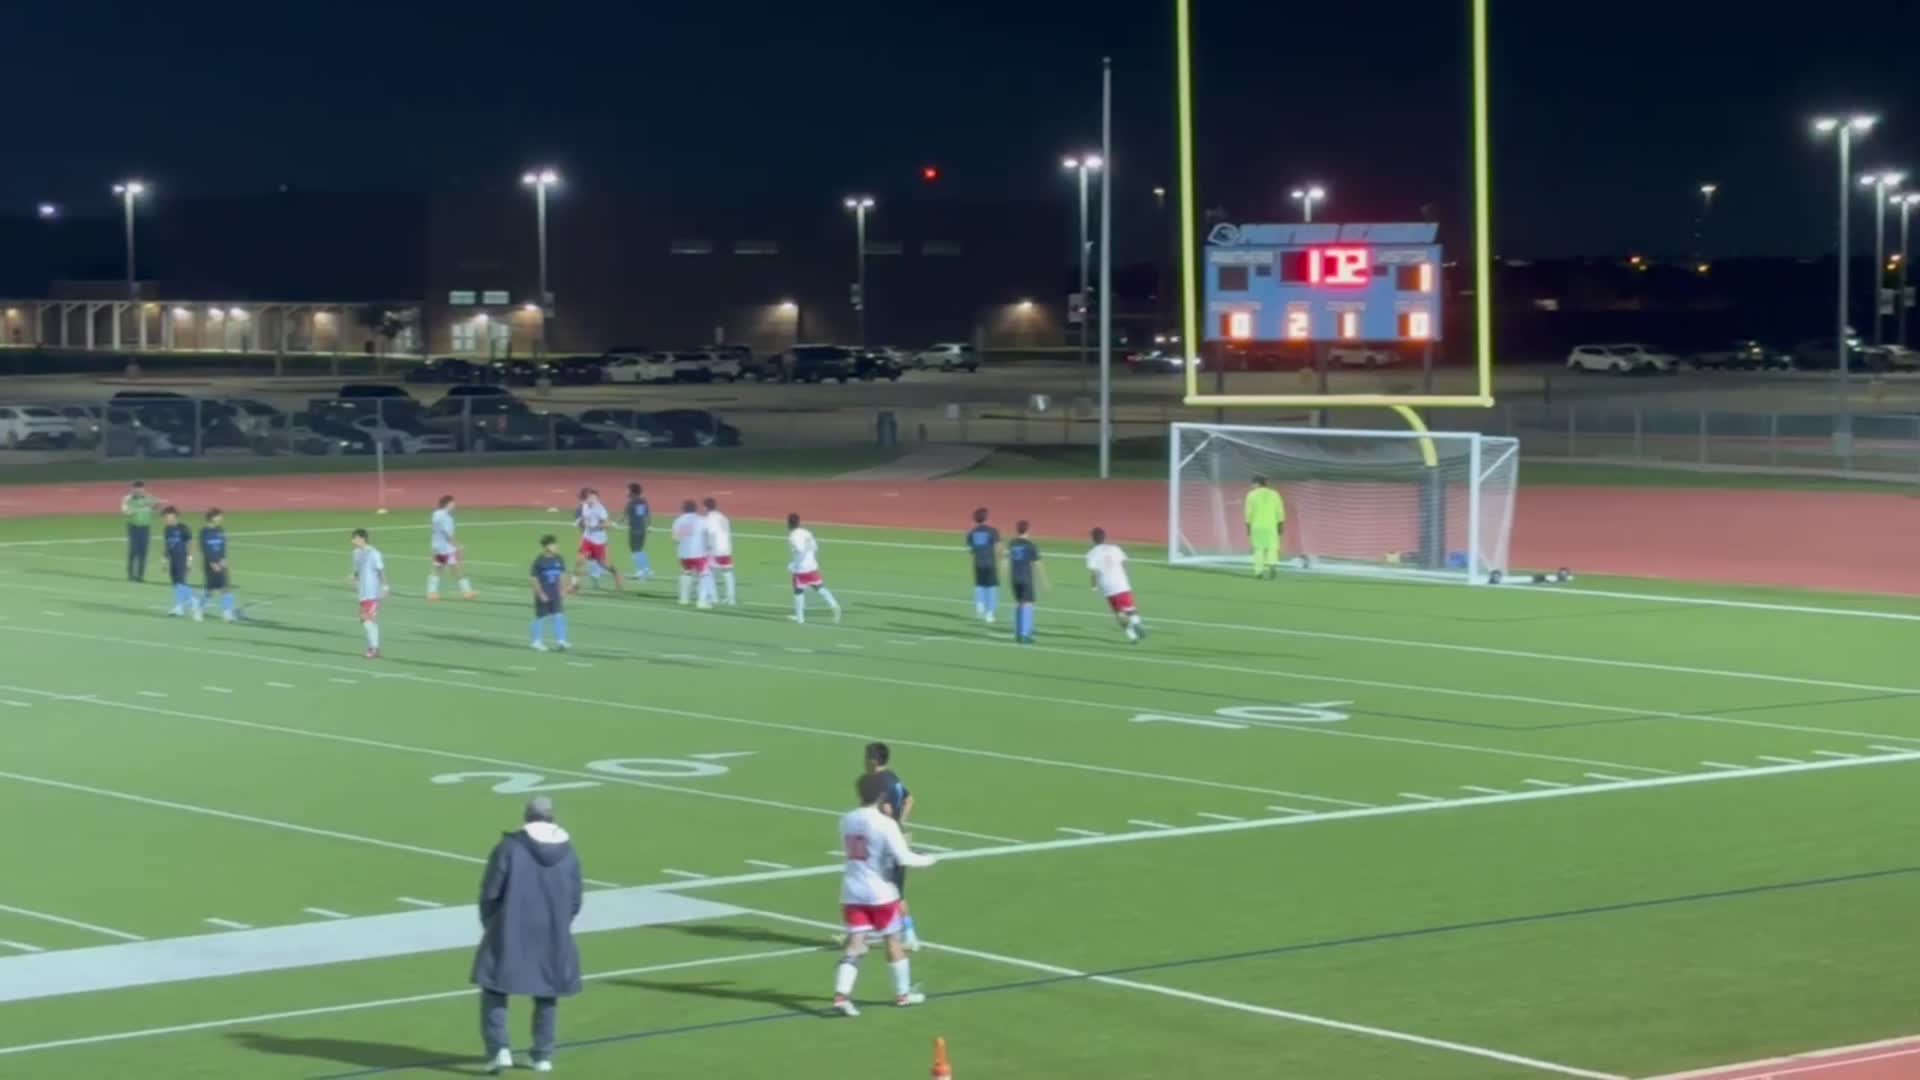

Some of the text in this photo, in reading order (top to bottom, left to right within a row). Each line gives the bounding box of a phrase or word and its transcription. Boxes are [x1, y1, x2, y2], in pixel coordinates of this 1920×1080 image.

[1288, 312, 1308, 338] 2
[1344, 312, 1356, 338] 1
[1408, 312, 1428, 338] 0
[430, 757, 731, 794] 20
